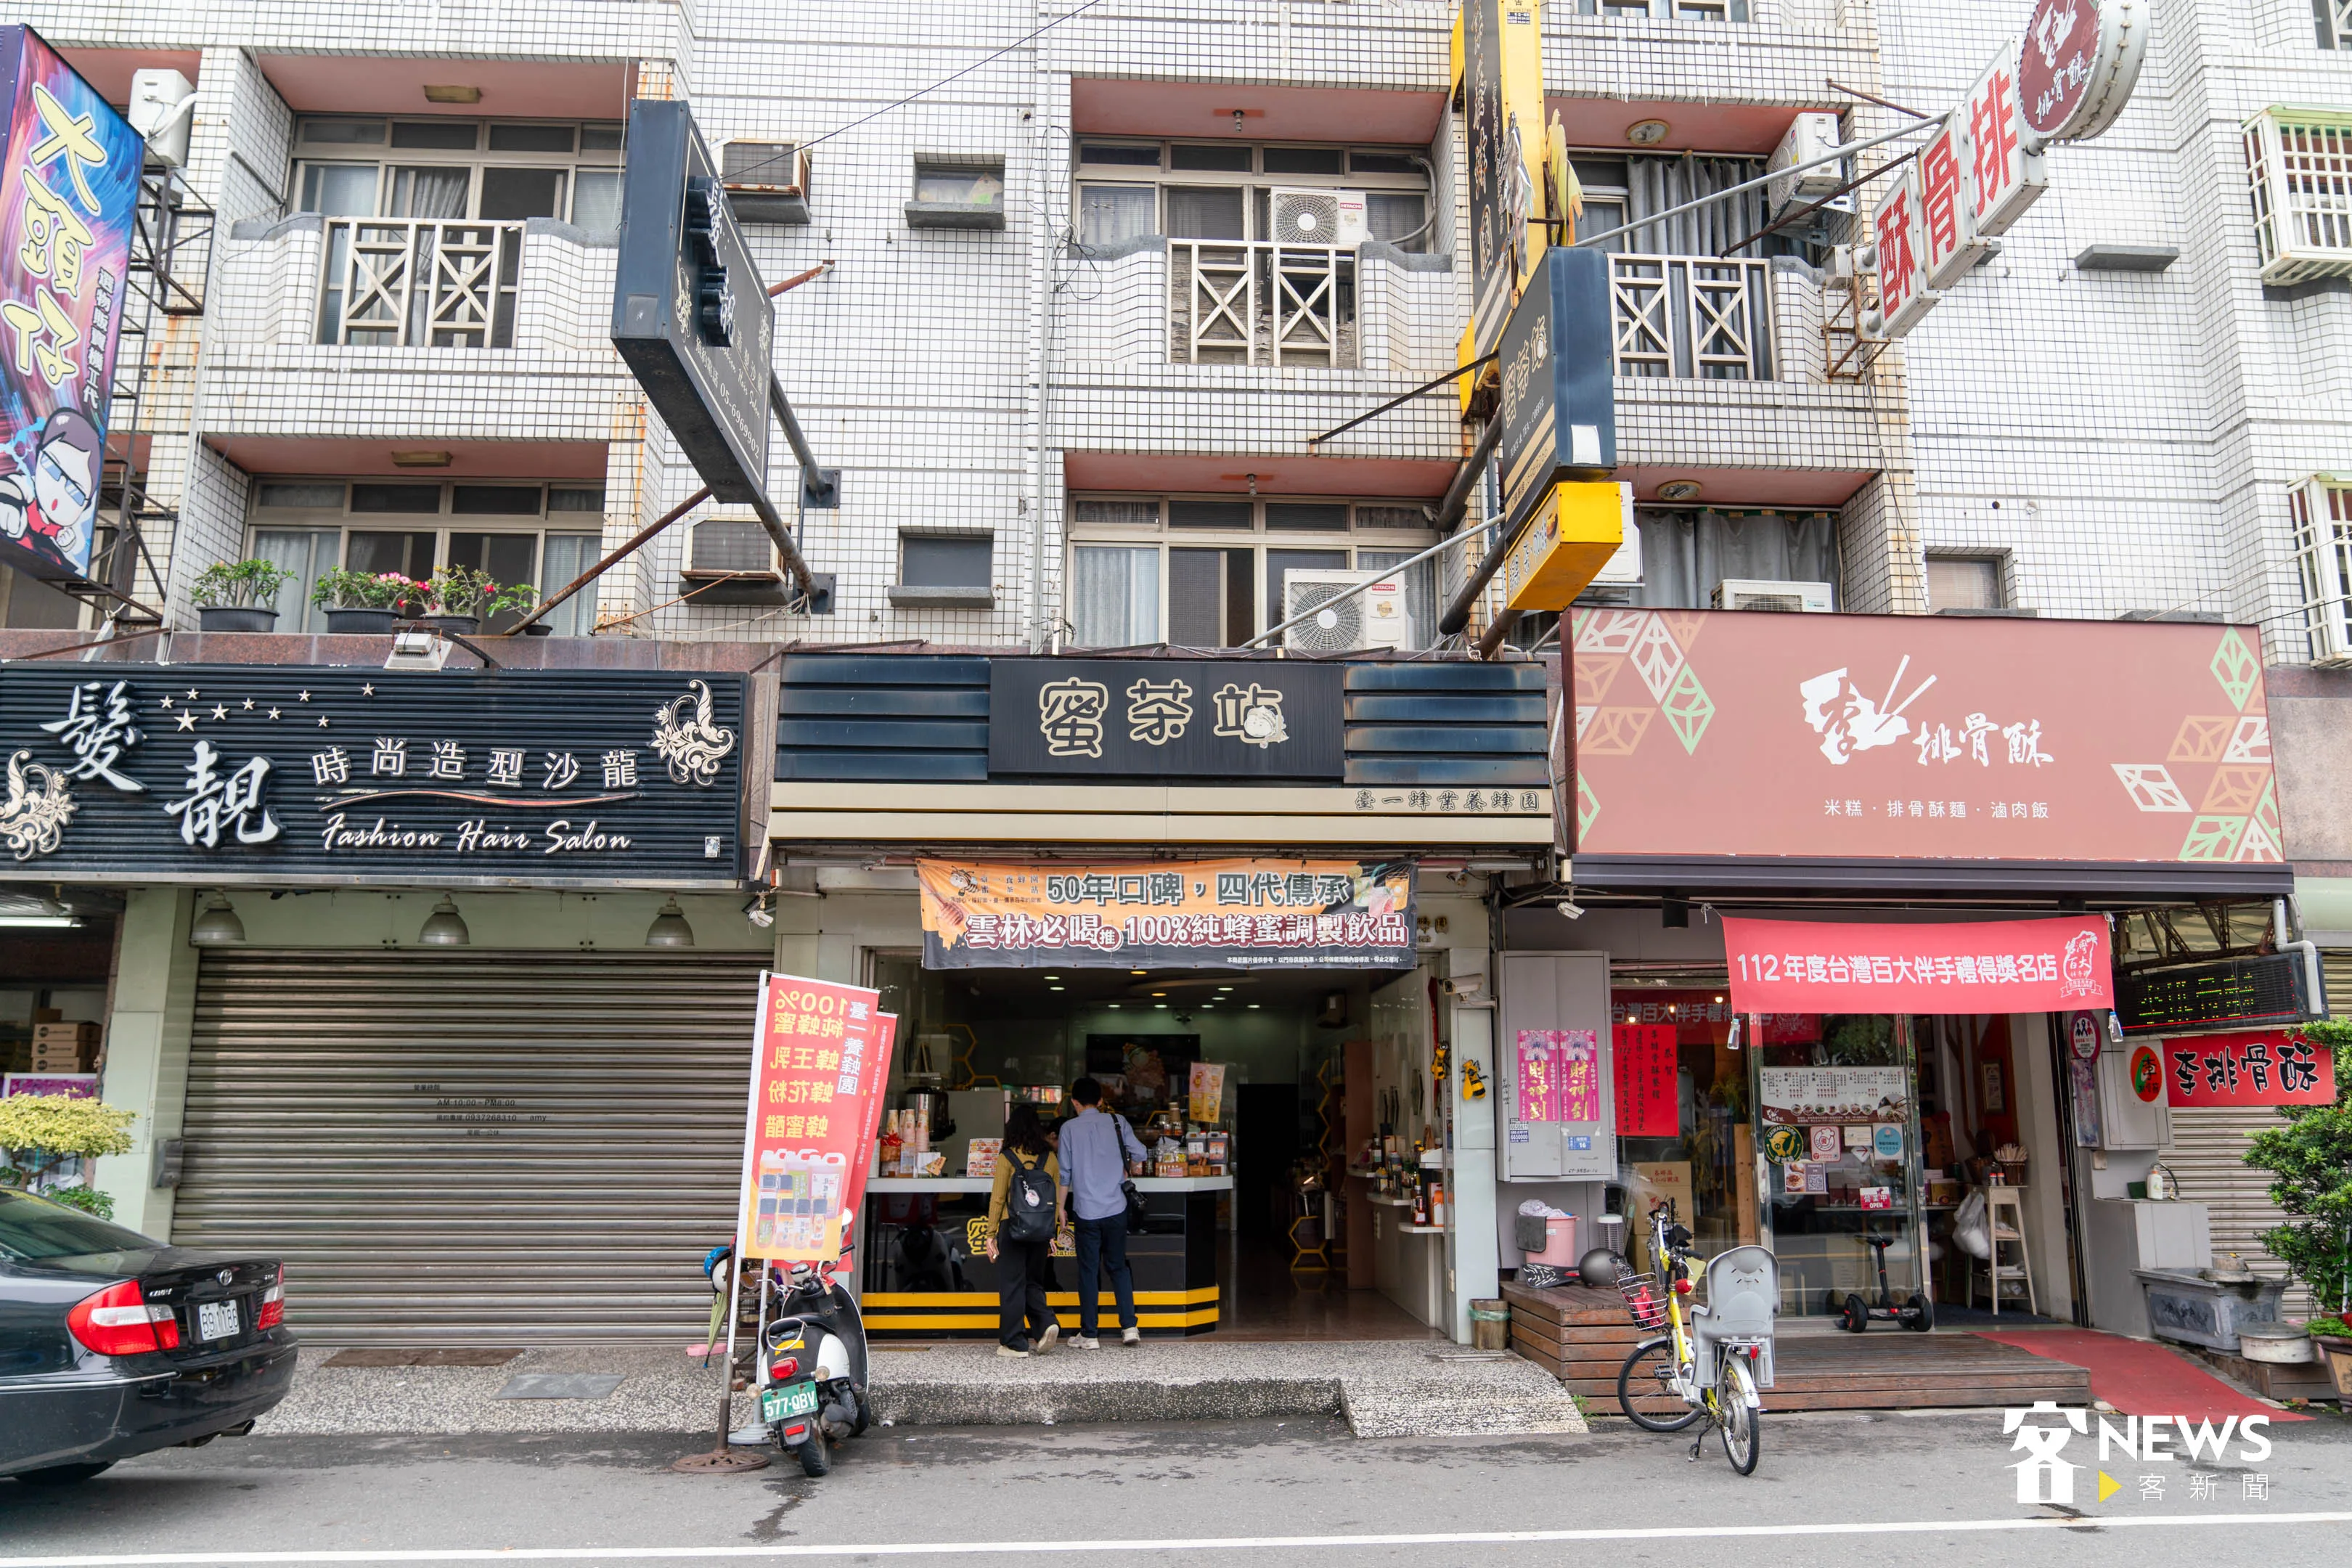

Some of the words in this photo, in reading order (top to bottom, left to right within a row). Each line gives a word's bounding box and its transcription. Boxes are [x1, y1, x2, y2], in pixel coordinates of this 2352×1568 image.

[1877, 70, 2017, 320] 排骨酥
[1, 83, 107, 390] 大頭仔
[720, 383, 759, 459] 05-6969902
[1039, 677, 1289, 758] 蜜茶站
[1912, 712, 2054, 767] 排骨酥
[311, 737, 639, 789] 時尚造型沙龍
[1355, 789, 1540, 812] 臺一蜂業養蜂園
[321, 812, 440, 852] Fashion
[456, 817, 530, 854] Hair
[544, 819, 632, 855] Salon
[965, 912, 1102, 948] 雲林必喝
[1124, 913, 1408, 946] 100%純蜂蜜調製飲品
[1527, 1061, 1549, 1121] 財神到
[1569, 1061, 1589, 1121] 財神到
[2173, 1041, 2319, 1096] 李排骨酥
